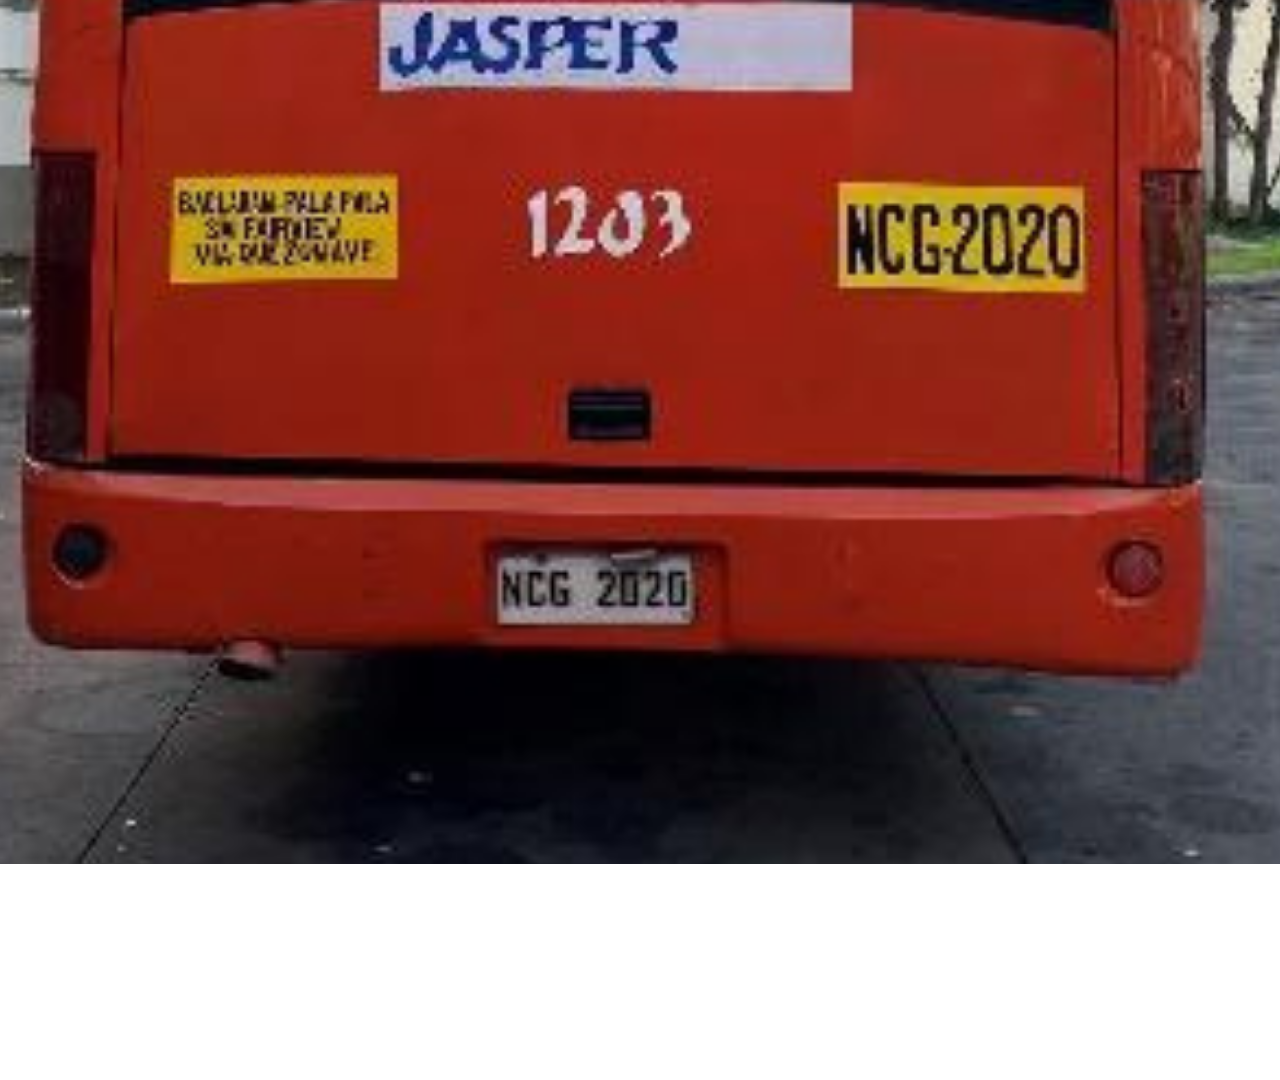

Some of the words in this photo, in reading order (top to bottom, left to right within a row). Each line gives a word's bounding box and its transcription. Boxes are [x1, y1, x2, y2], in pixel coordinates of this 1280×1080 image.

[388, 11, 679, 77] JASPER
[527, 185, 692, 259] 1203
[502, 570, 570, 608] NCG
[597, 570, 688, 607] 2020
